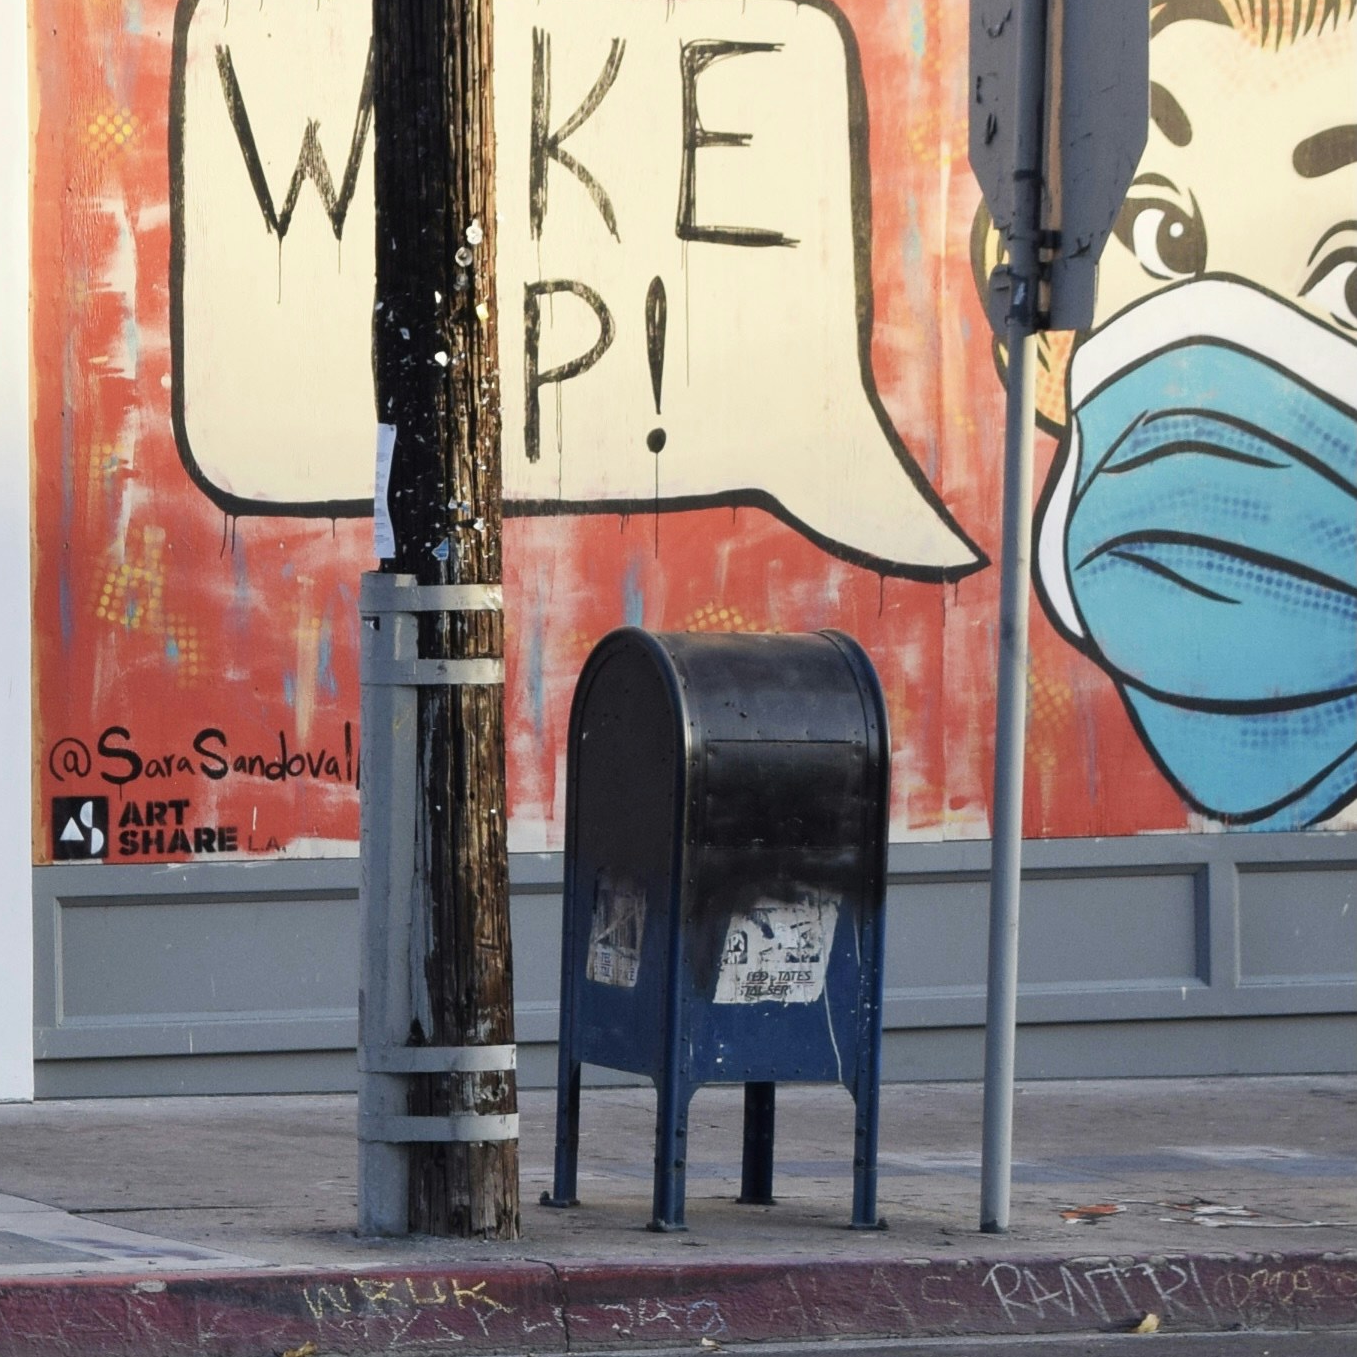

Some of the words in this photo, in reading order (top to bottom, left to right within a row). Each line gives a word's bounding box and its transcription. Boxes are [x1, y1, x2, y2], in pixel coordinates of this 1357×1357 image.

[216, 25, 800, 247] WKE
[524, 275, 667, 463] P!
[49, 721, 360, 790] @SaraSandoval
[118, 797, 190, 828] ART
[118, 826, 238, 856] SHARE
[778, 970, 812, 981] TATES
